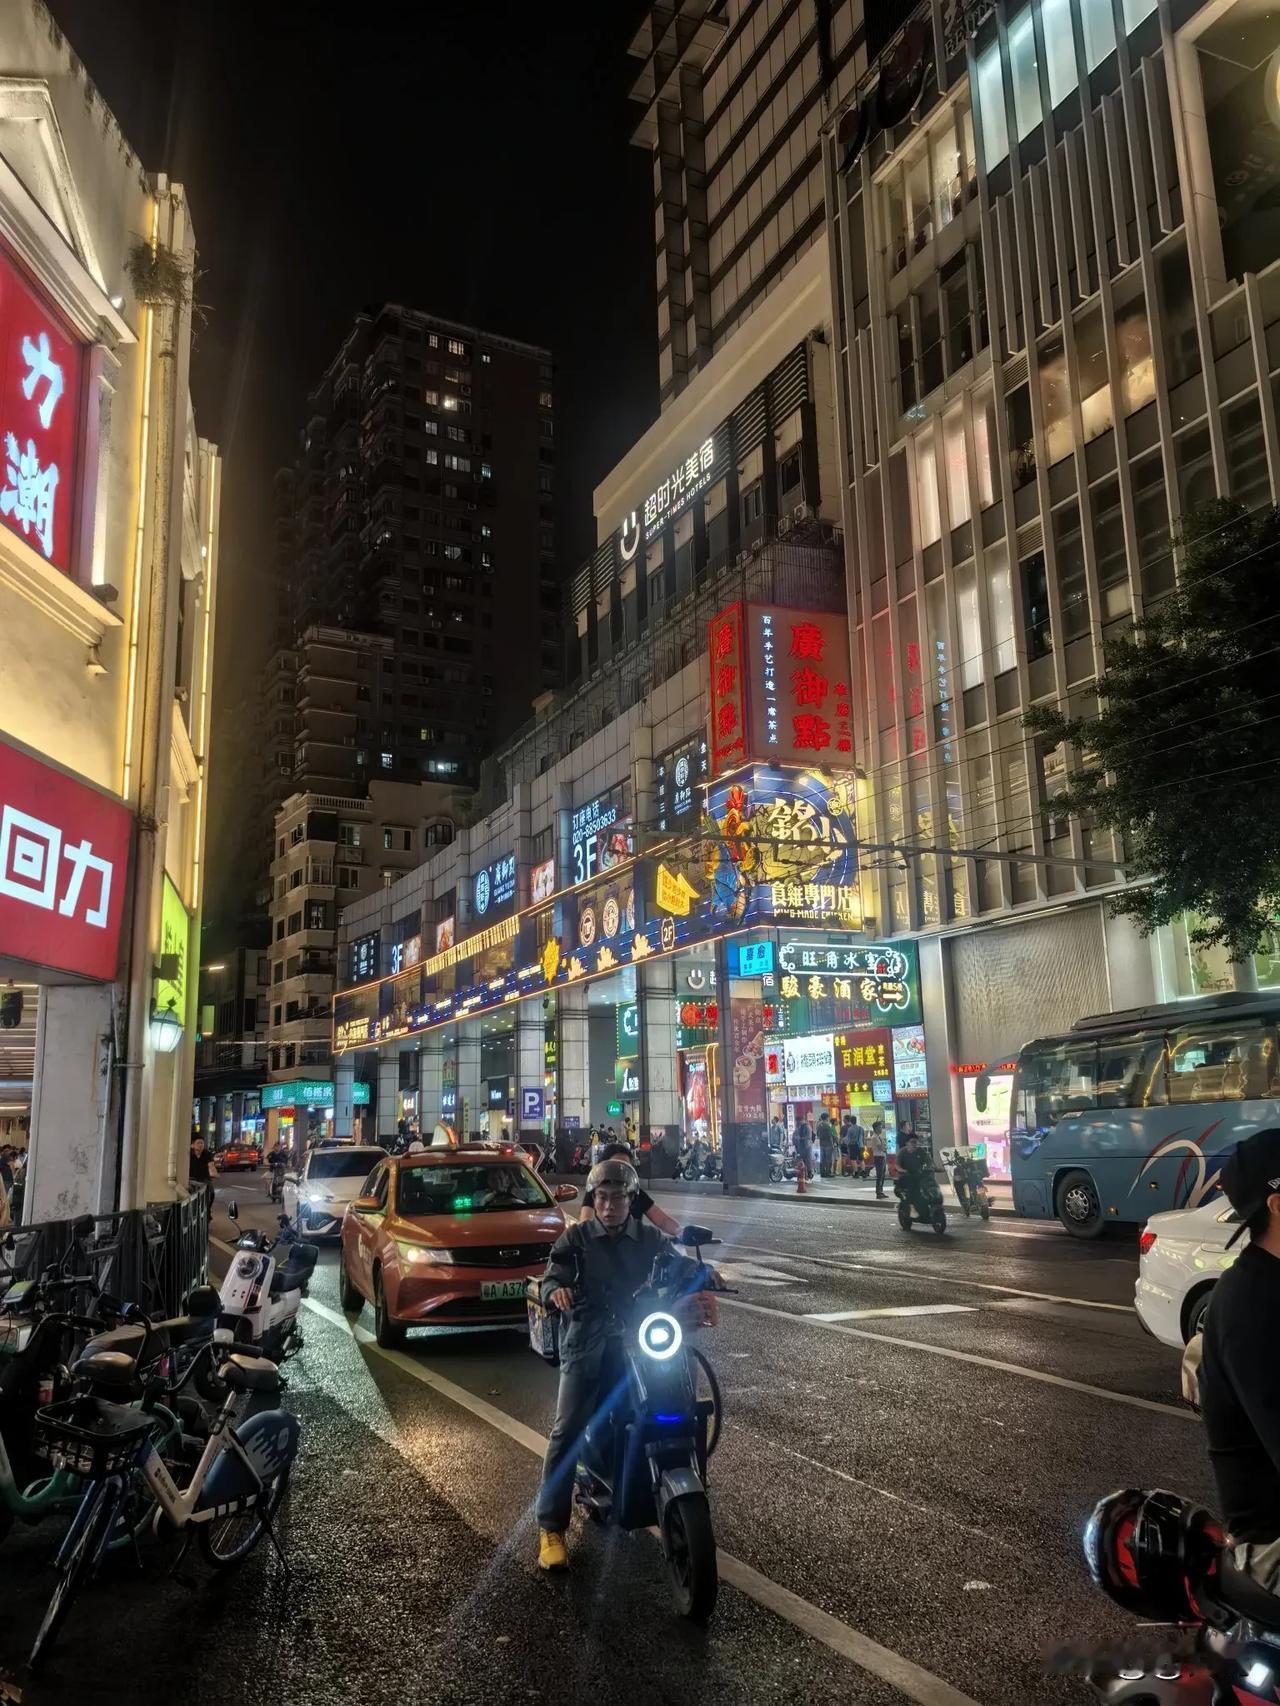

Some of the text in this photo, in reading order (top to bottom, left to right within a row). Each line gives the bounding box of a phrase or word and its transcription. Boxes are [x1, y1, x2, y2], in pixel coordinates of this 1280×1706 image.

[644, 437, 715, 527] 超时光美宿
[645, 472, 712, 540] SUPER-TIMES HOTELS
[0, 804, 113, 929] 回力
[573, 835, 598, 885] 3F
[663, 926, 673, 941] 2F
[391, 943, 404, 975] 3F
[802, 950, 877, 971] 旺角冰室
[841, 1045, 877, 1068] 百润堂
[524, 1092, 540, 1114] P
